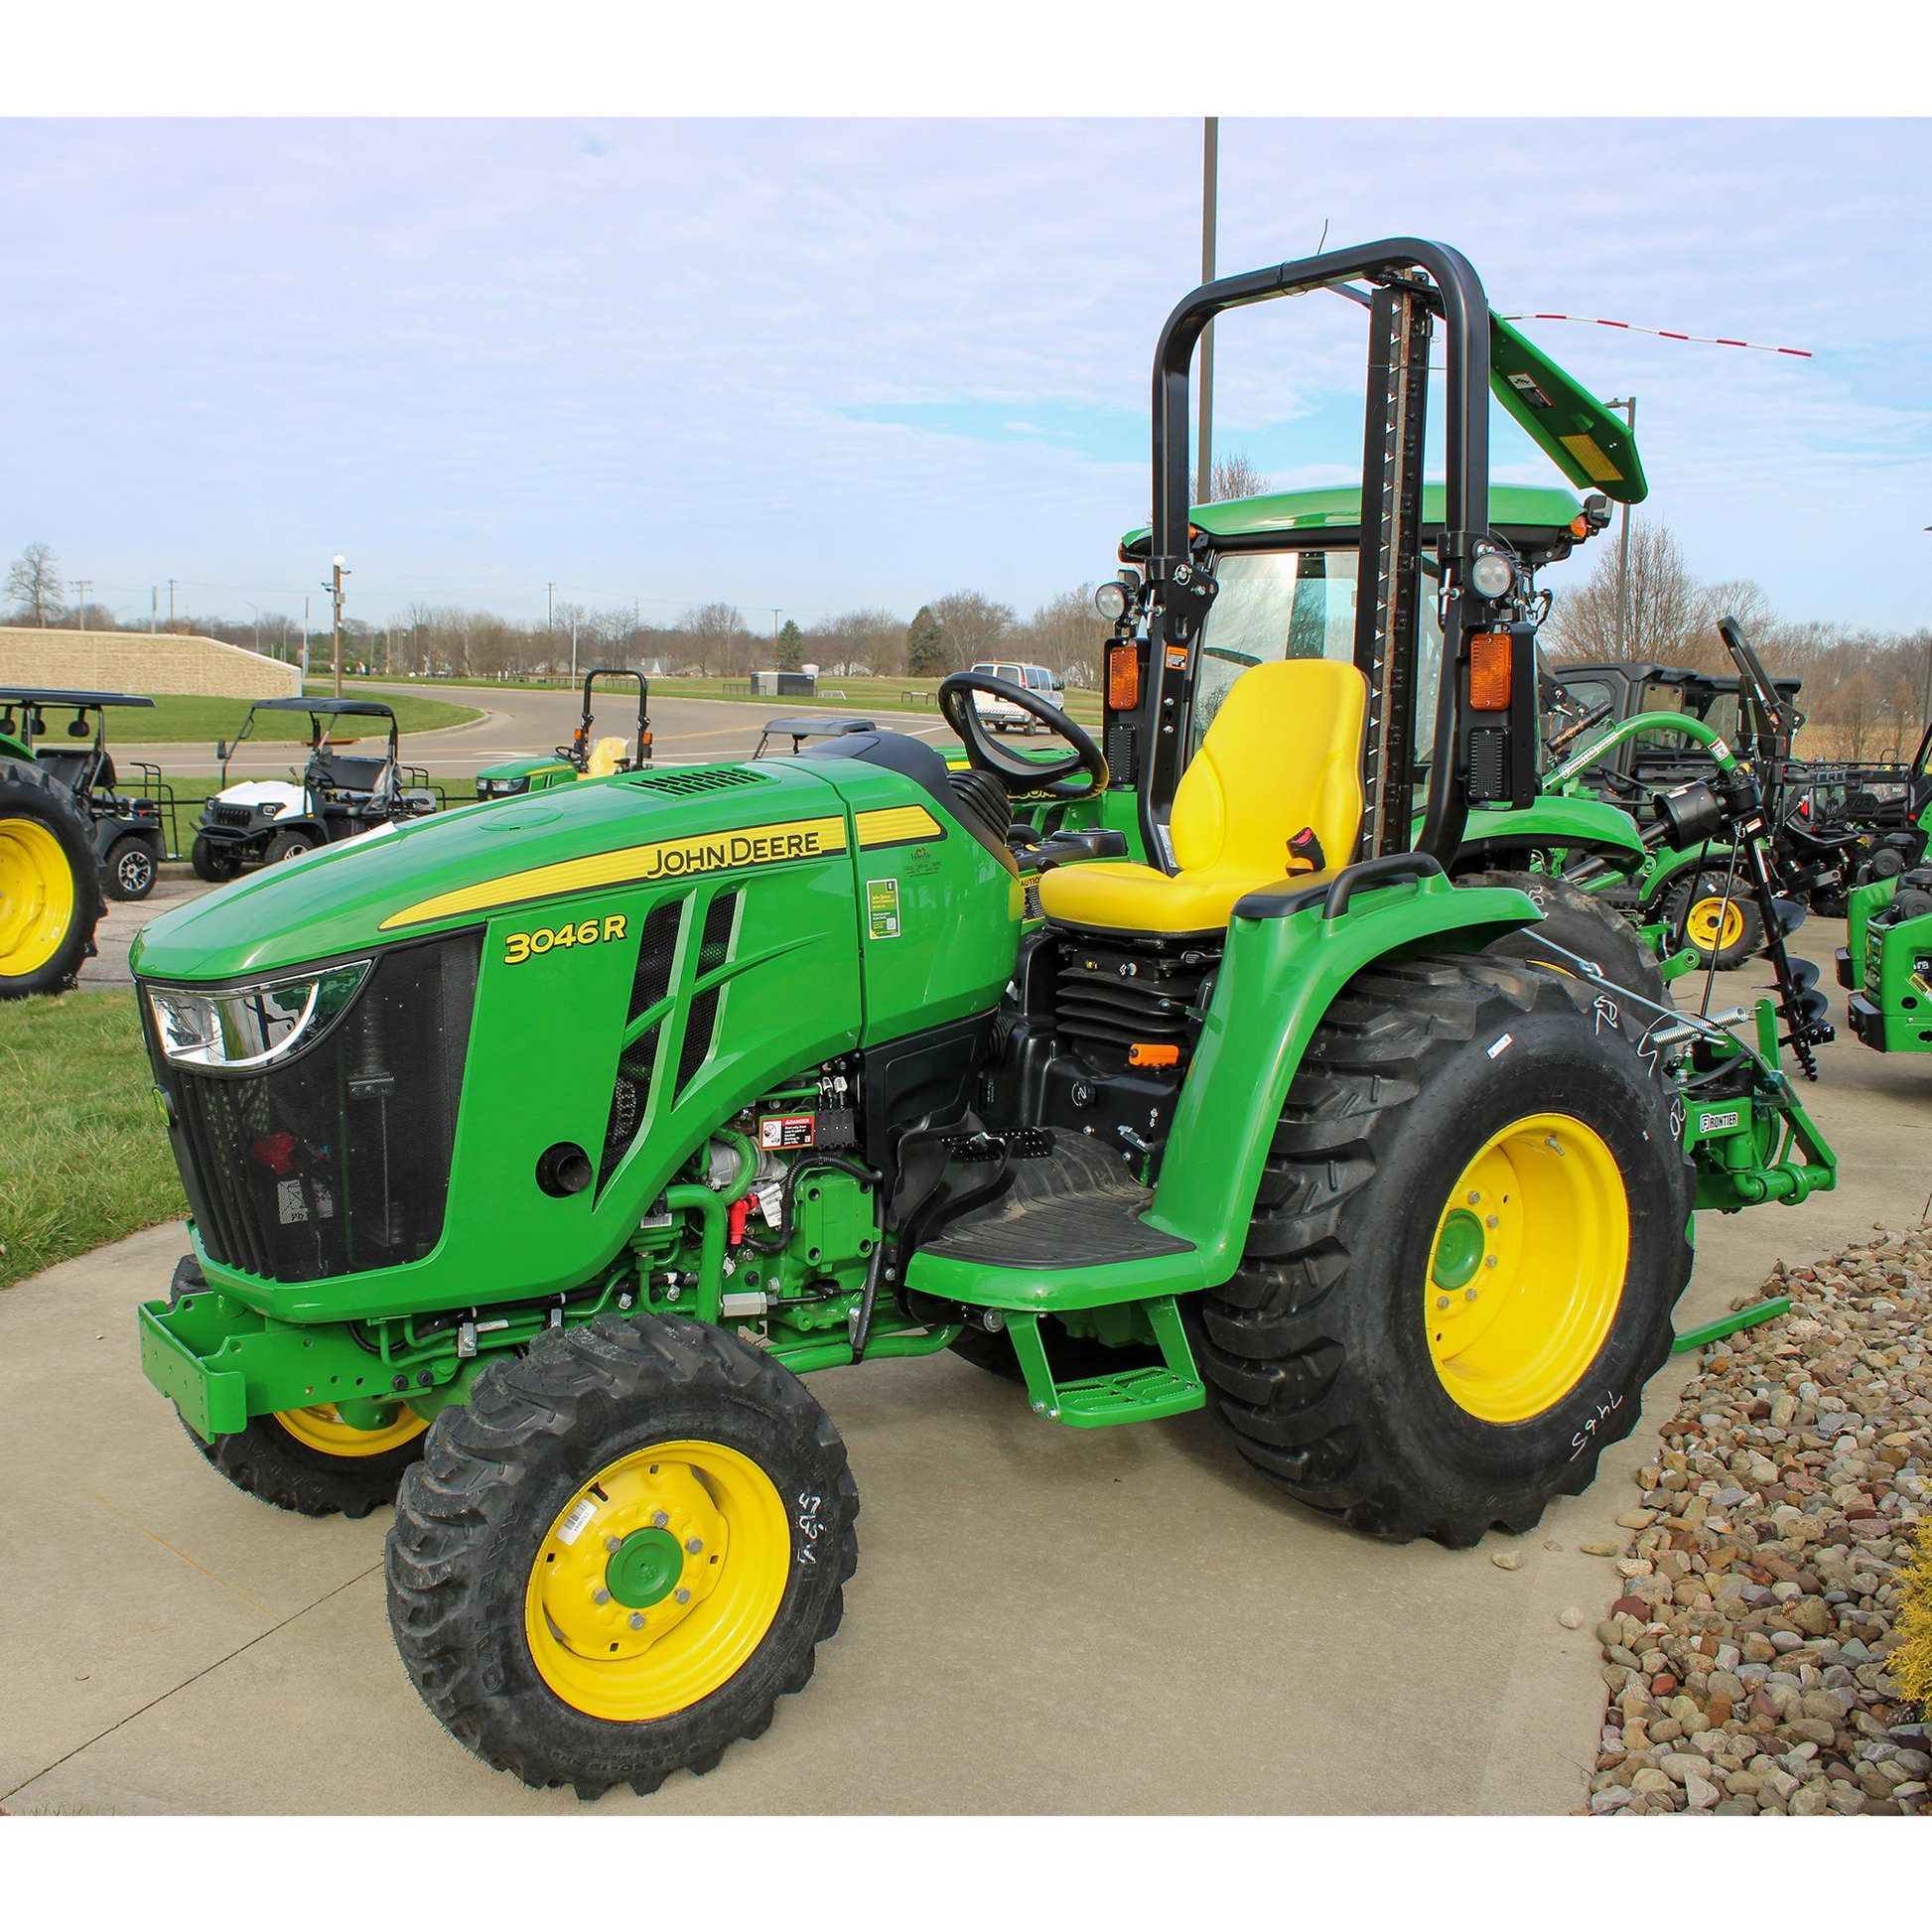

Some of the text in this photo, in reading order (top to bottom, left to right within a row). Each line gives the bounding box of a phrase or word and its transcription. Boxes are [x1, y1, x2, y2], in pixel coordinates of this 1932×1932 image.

[647, 832, 821, 877] JOHN DEERE
[1701, 1113, 1737, 1132] FRONTIER
[1569, 1390, 1623, 1461] 7465
[473, 1498, 527, 1694] GALAXY
